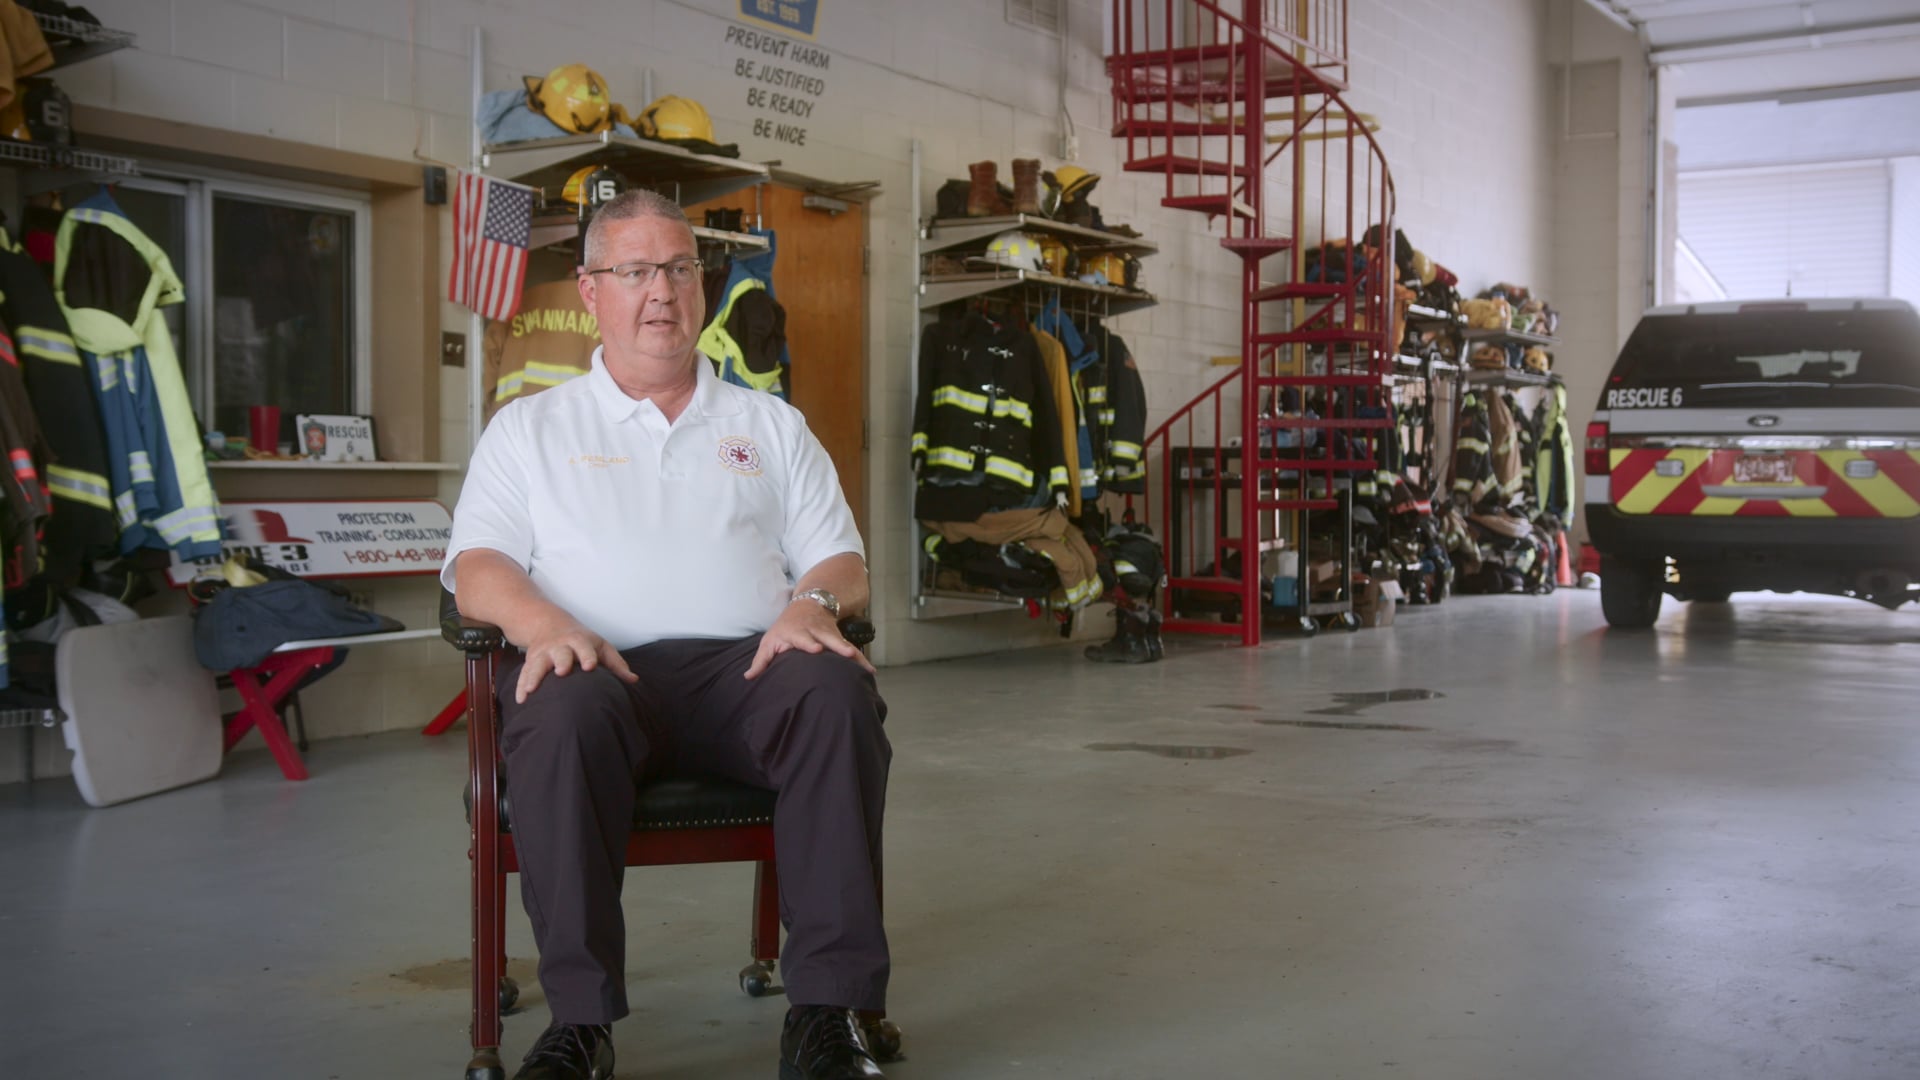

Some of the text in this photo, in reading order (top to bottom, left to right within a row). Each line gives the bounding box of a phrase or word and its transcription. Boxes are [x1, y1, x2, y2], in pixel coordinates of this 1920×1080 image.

[725, 25, 830, 70] PREVENT HARM
[735, 58, 825, 97] BE JUSTIFIED
[746, 87, 815, 119] BE READY
[753, 118, 807, 147] BE NICE
[511, 308, 601, 340] SWANNANO
[1607, 387, 1683, 409] RESCUE 6
[327, 425, 369, 455] RESCUE 6
[337, 512, 416, 526] PROTECTION
[316, 529, 377, 543] TRAINING
[280, 544, 309, 561] 3
